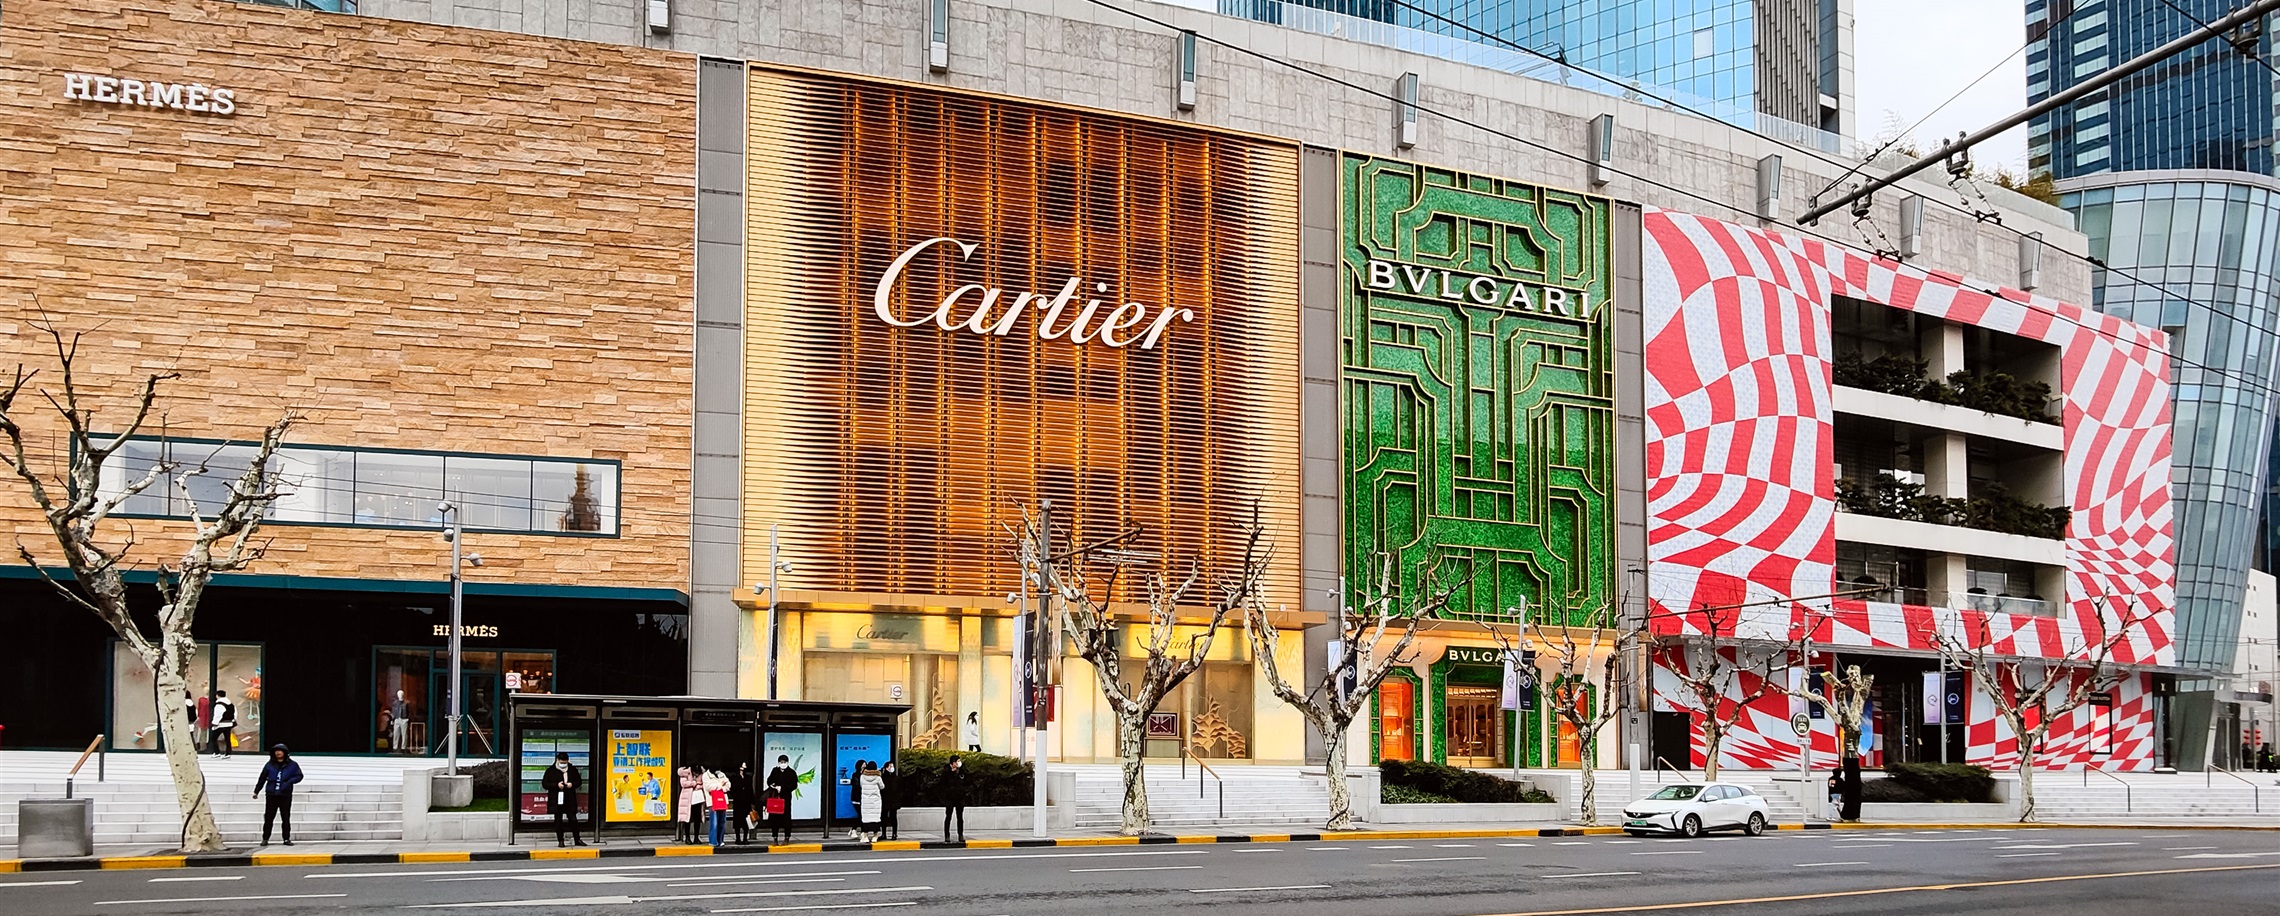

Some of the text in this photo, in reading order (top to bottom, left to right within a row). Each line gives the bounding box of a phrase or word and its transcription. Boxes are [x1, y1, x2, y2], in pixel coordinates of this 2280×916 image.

[64, 73, 235, 115] HERMÈS
[874, 236, 1194, 350] Cartier
[1368, 259, 1590, 318] BVLGARI
[857, 624, 909, 640] Cartier
[1449, 649, 1505, 663] BVLGA
